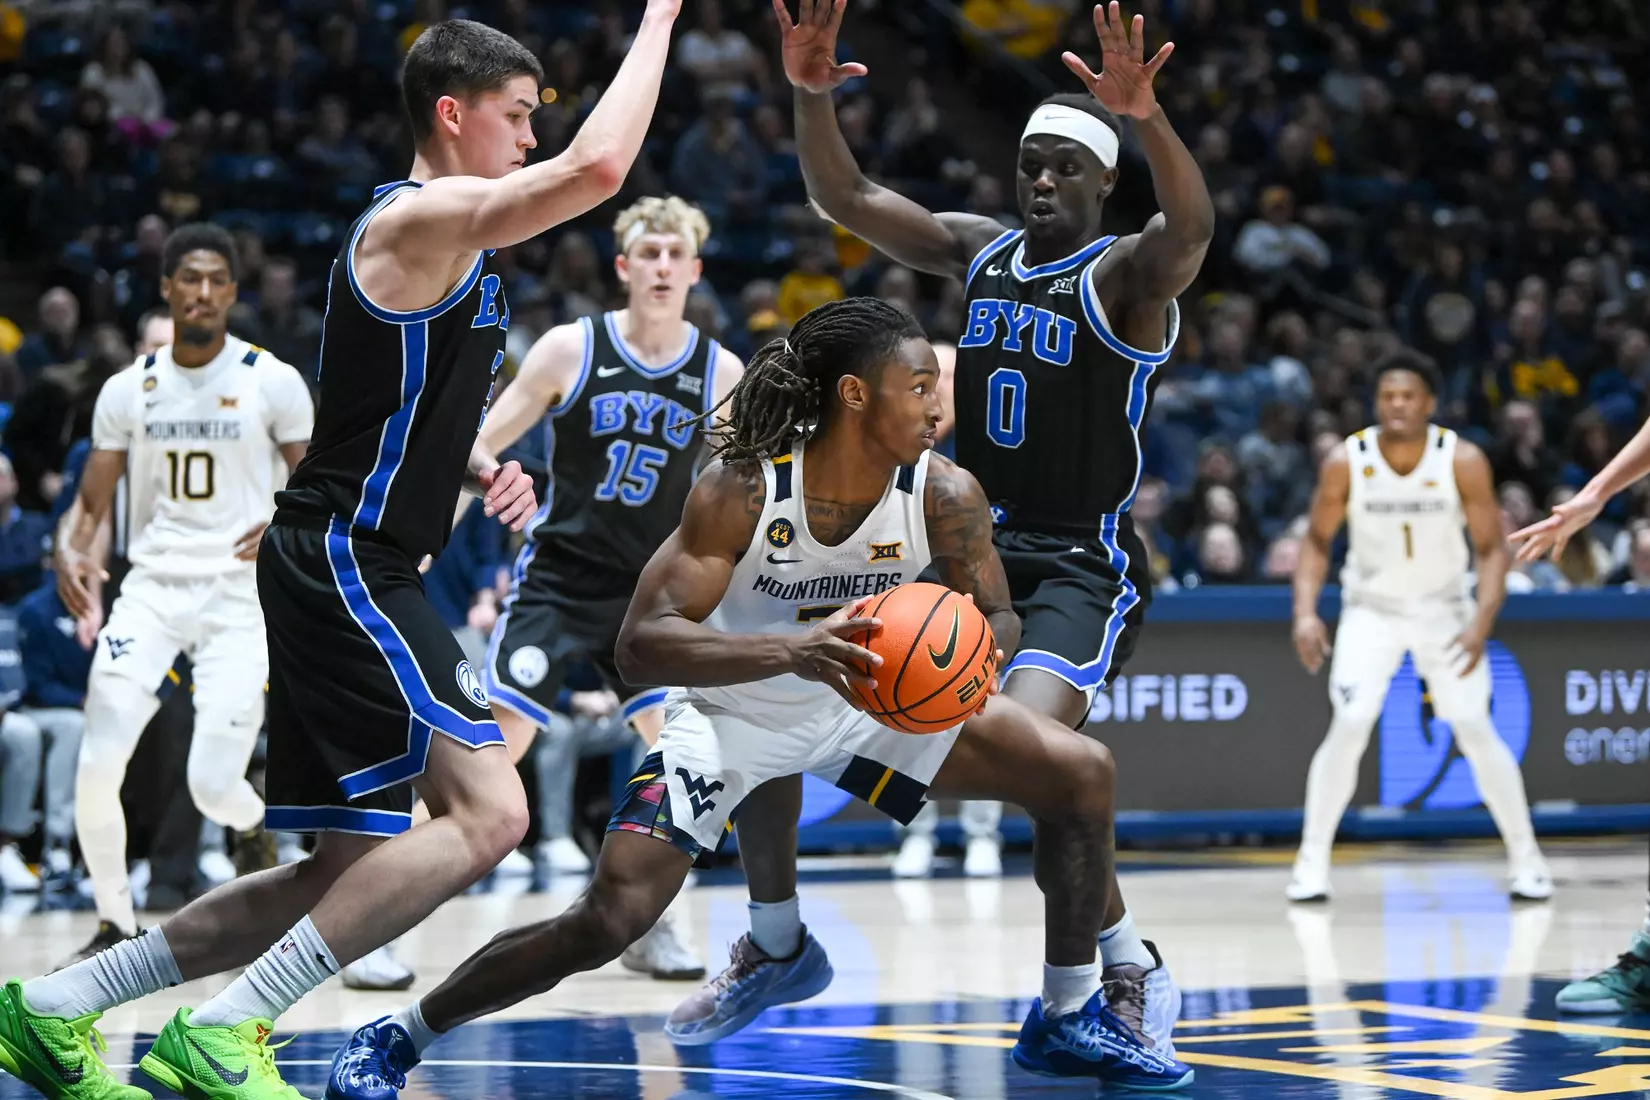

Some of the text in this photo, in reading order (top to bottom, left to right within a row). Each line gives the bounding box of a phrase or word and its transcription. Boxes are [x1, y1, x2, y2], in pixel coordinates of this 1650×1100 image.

[958, 298, 1077, 366] BYU
[589, 390, 697, 450] BYU
[986, 367, 1027, 449] 0
[165, 450, 214, 500] 10
[594, 439, 669, 506] 15
[770, 528, 789, 544] 44
[1401, 522, 1414, 562] 1
[752, 573, 903, 601] MOUNTAINEERS
[956, 634, 997, 705] ELITE
